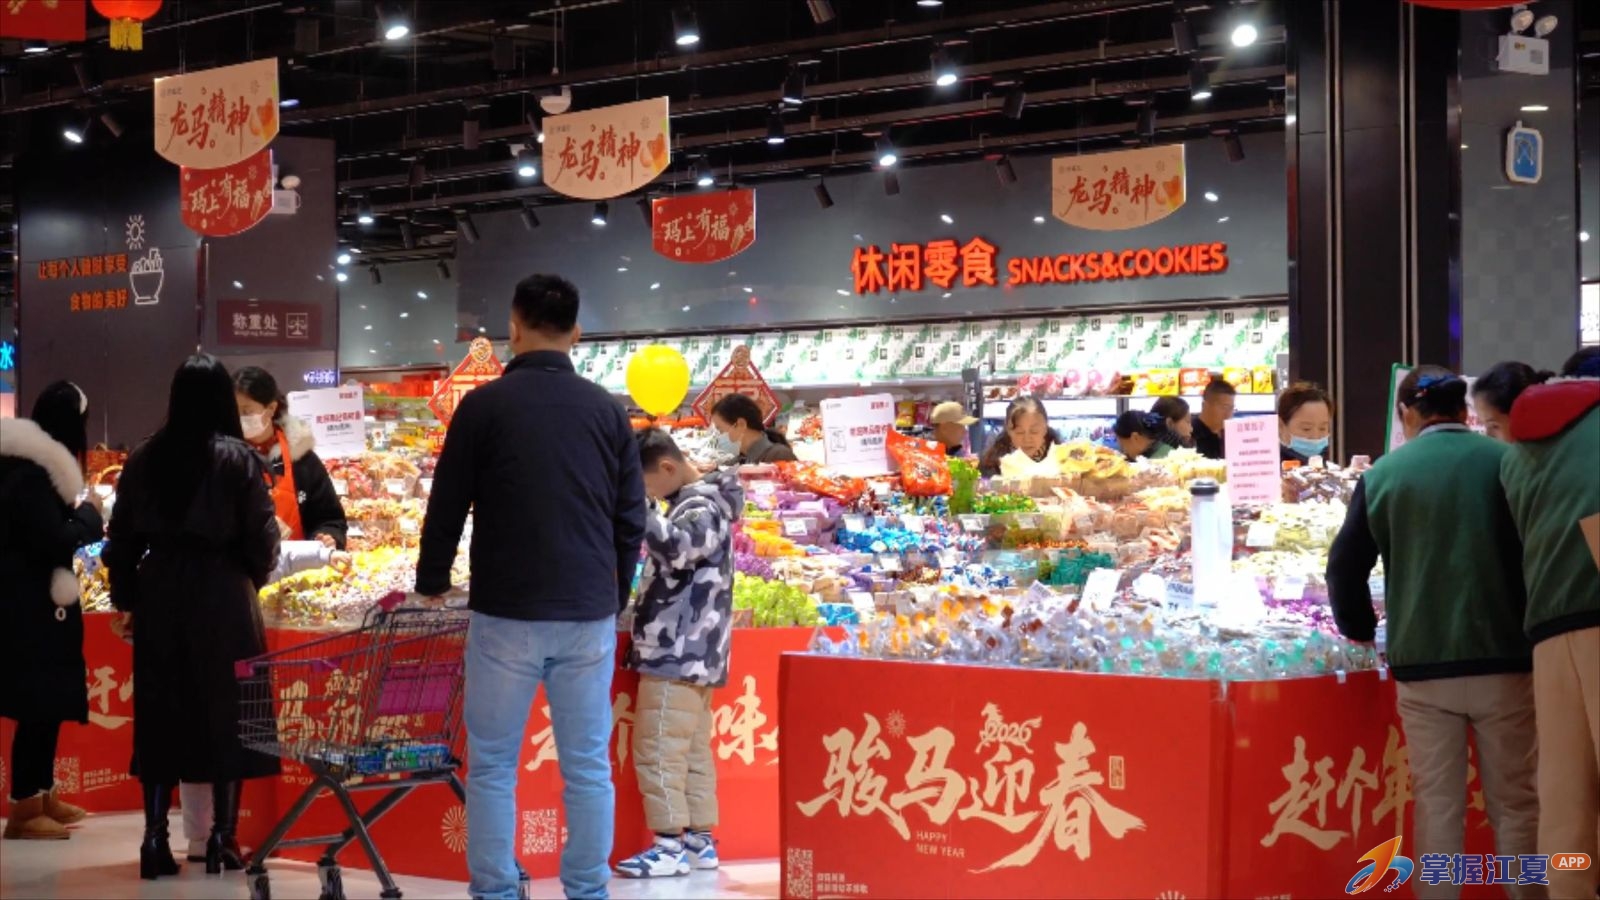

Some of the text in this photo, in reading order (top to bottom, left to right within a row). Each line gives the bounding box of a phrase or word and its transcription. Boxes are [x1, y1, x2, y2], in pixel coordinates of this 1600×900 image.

[162, 88, 250, 155] 龙马精神
[552, 125, 640, 184] 龙马精神
[189, 173, 250, 219] 玛上有福
[1061, 166, 1156, 221] 龙马精神
[661, 208, 730, 250] 玛上有福
[852, 236, 997, 292] 休闲零食
[1007, 242, 1228, 286] SNACKS&COOKIES
[70, 289, 128, 312] 食物的美好
[232, 312, 279, 330] 称重处
[985, 719, 1032, 743] 2026
[795, 712, 1147, 873] 骏马迎春
[916, 830, 948, 843] HAPPY
[916, 842, 966, 859] NEW YEAR
